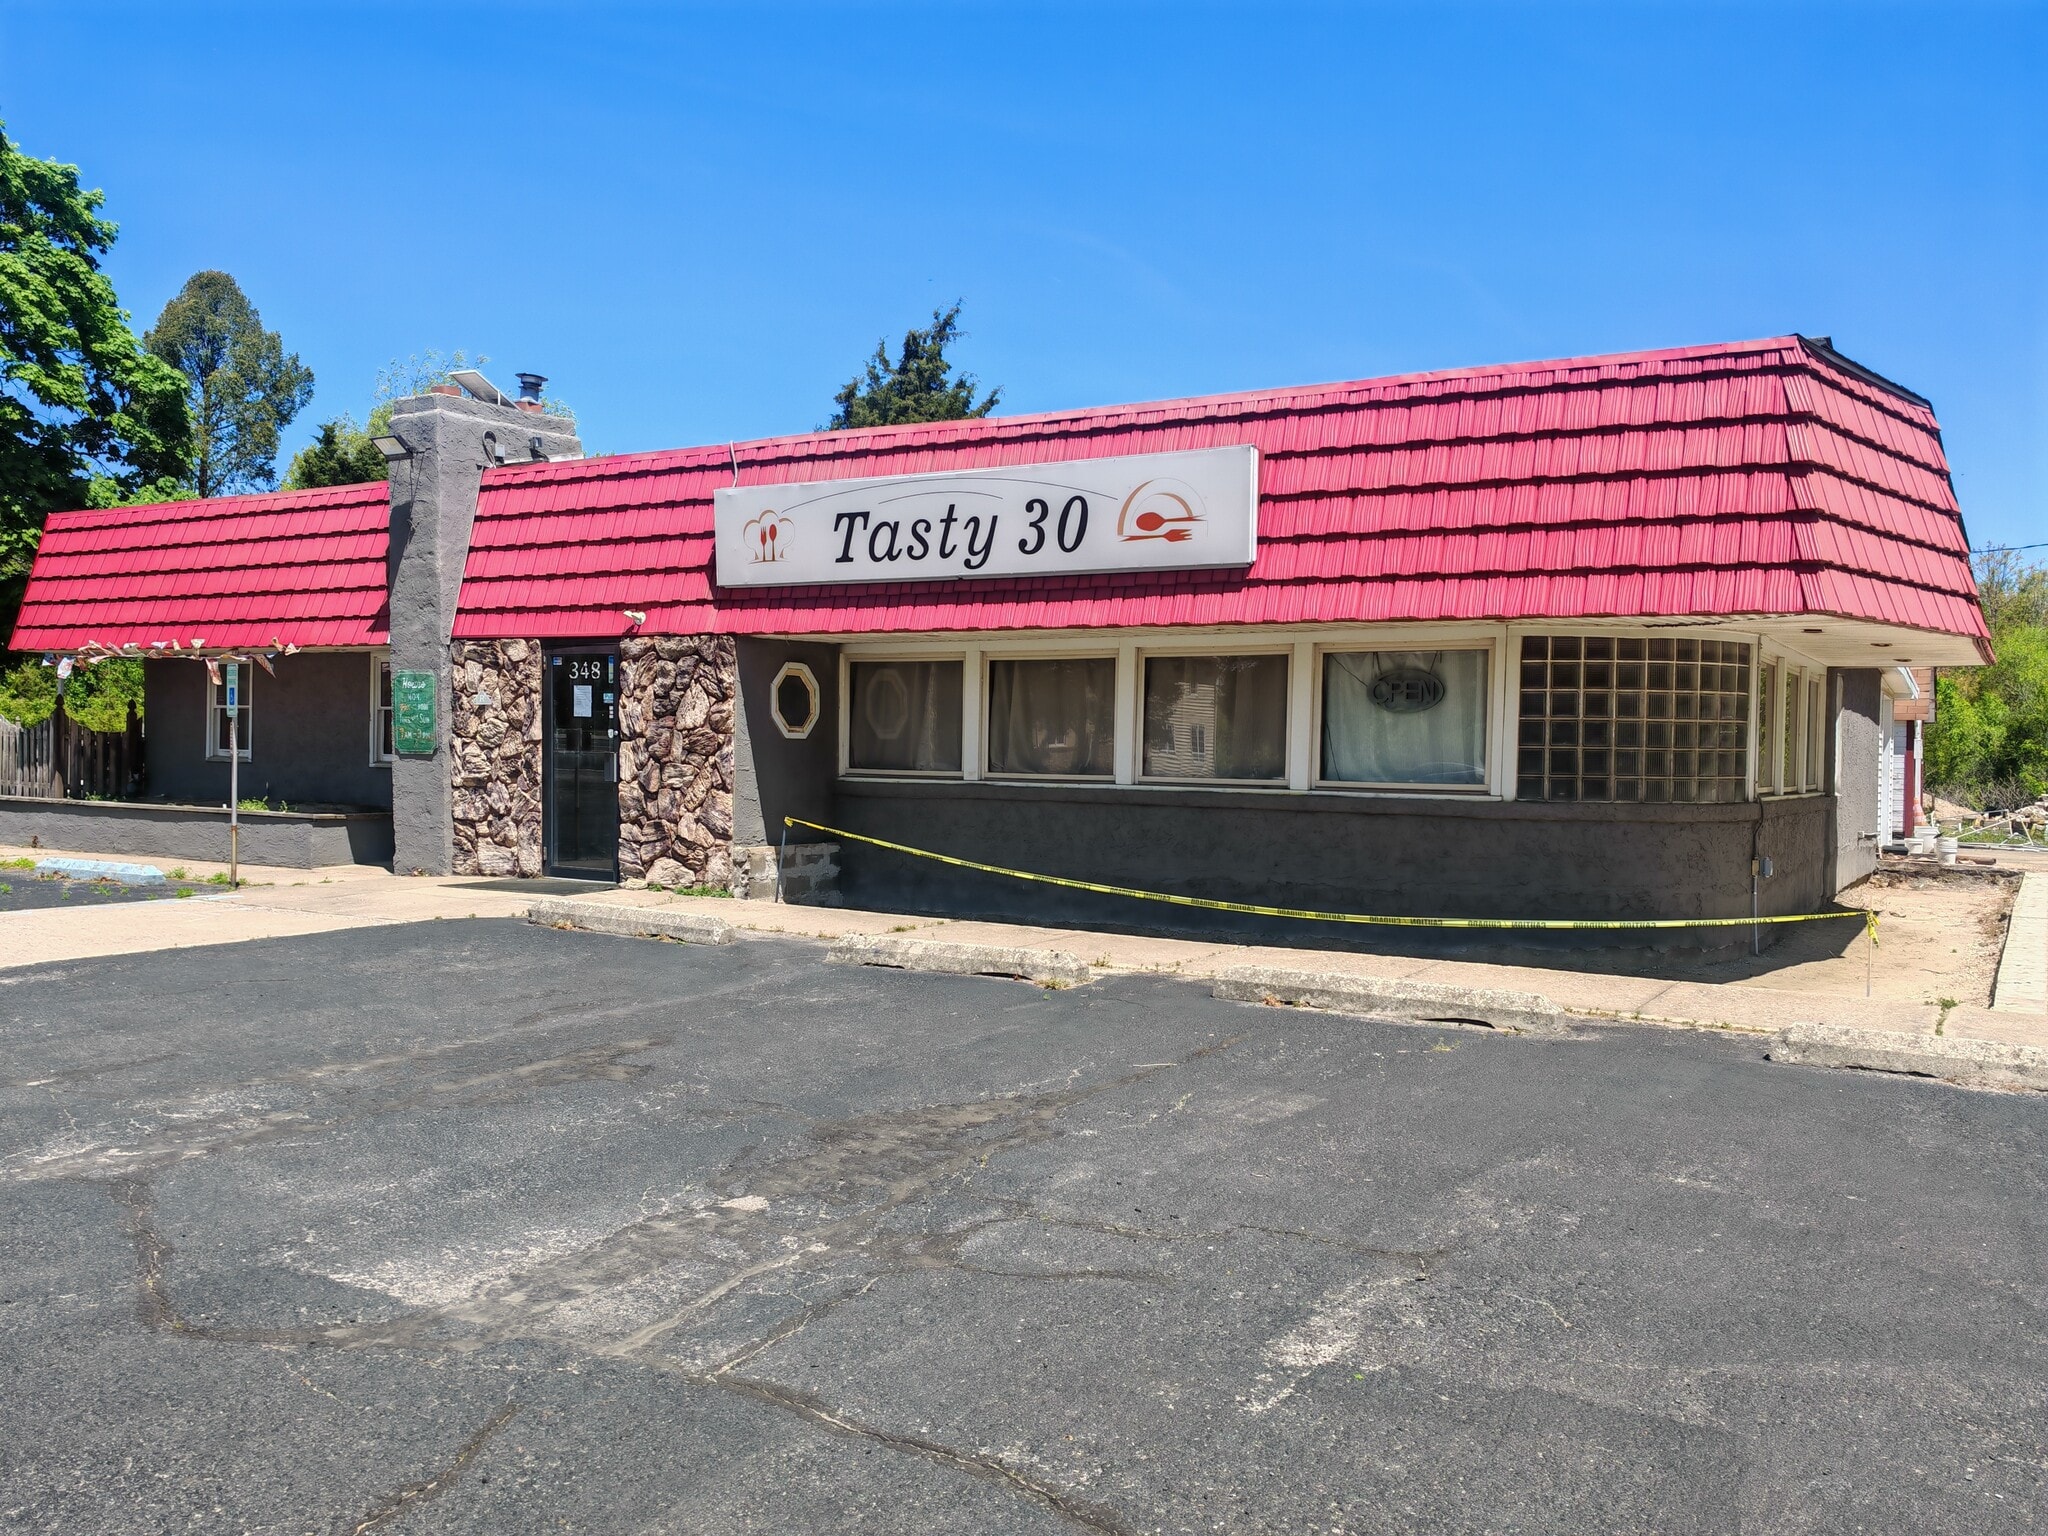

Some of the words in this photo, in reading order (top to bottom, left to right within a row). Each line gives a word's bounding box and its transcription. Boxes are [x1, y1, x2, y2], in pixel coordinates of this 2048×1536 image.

[833, 503, 998, 570] Tasty
[1018, 495, 1089, 555] 30
[569, 661, 600, 679] 348
[1373, 679, 1436, 703] OPEN
